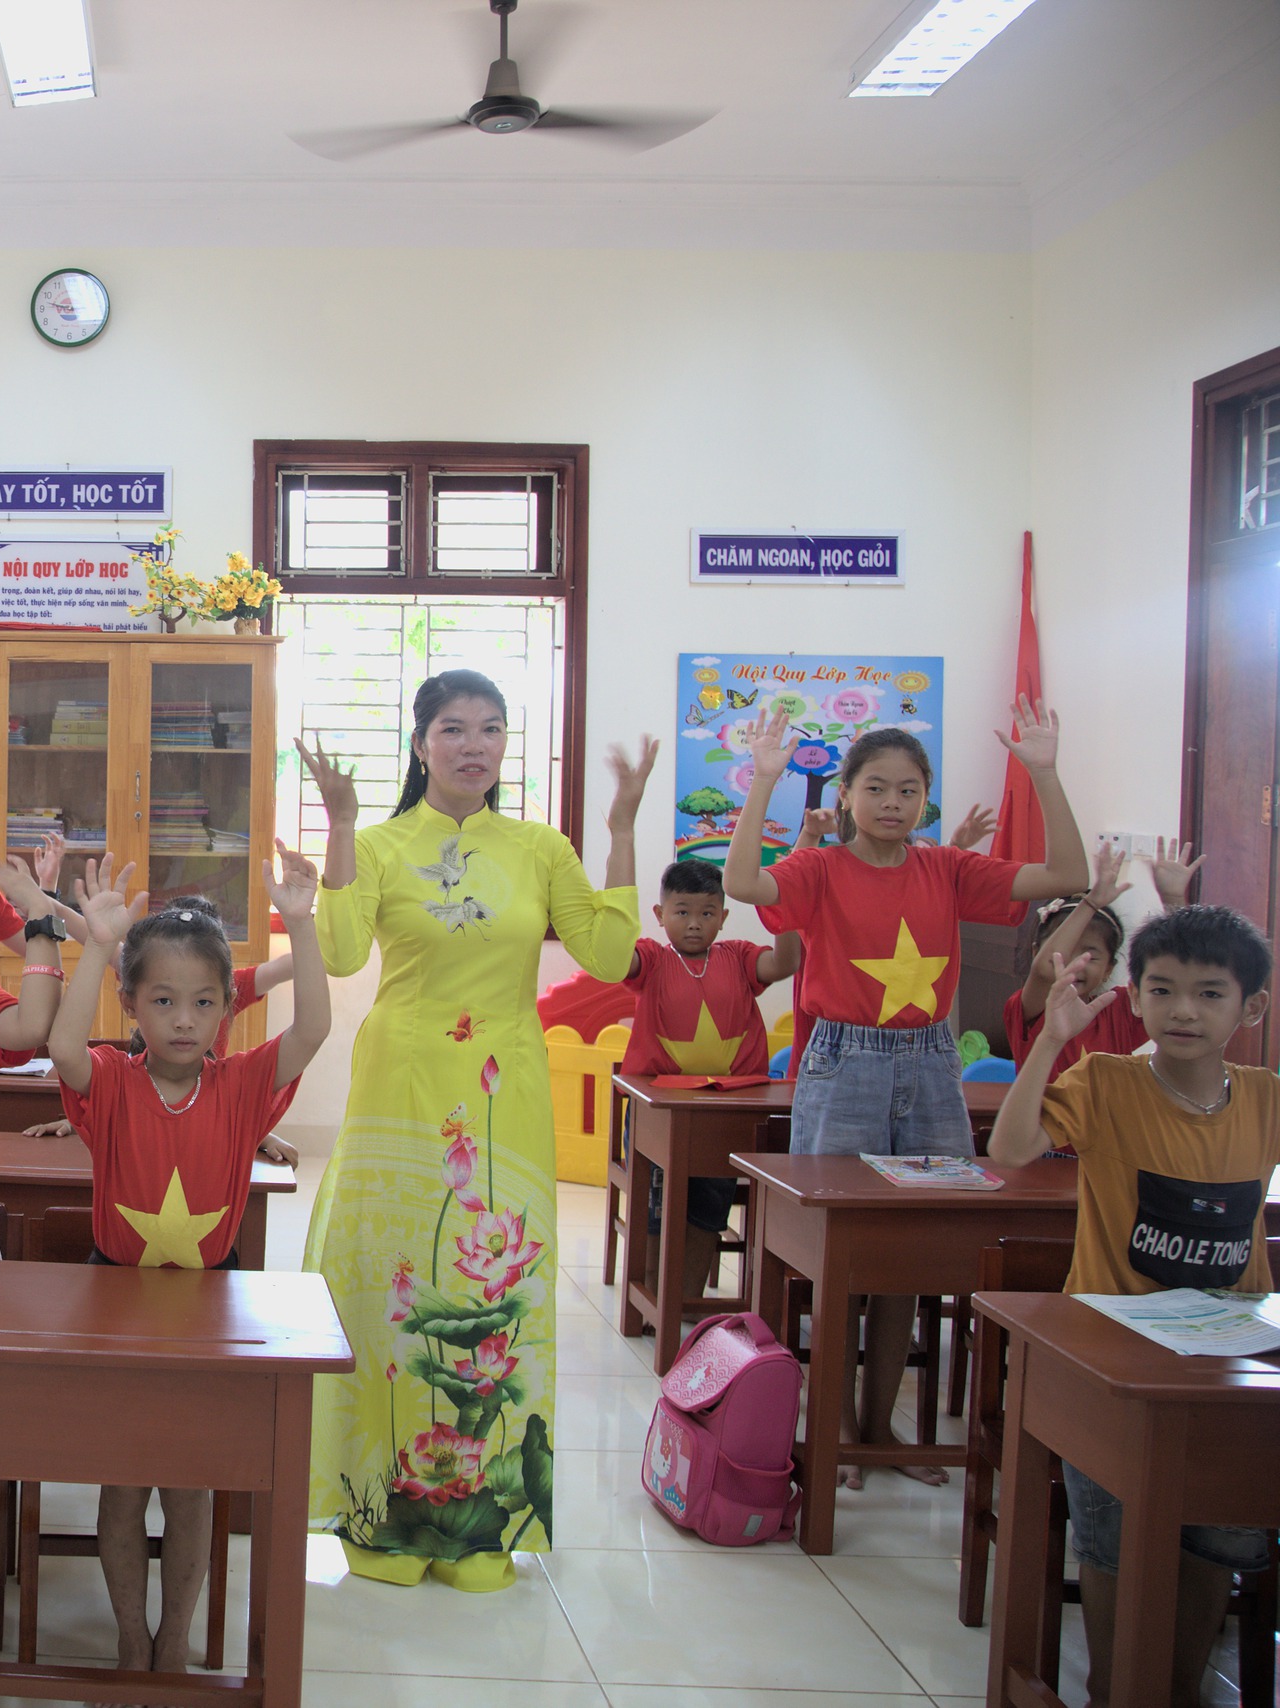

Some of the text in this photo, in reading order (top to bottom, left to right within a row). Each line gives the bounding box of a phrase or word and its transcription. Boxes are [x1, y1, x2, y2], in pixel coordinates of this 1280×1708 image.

[40, 305, 45, 313] 9
[43, 318, 48, 326] 8
[54, 328, 58, 336] 7
[67, 332, 72, 340] 6
[22, 477, 65, 506] TỐT,
[73, 484, 113, 507] HỌC
[119, 477, 157, 504] TỐT
[706, 543, 890, 570] CHĂM NGOAN, HỌC GIỎI
[3, 558, 128, 582] NỘI QUY LỚP HỌC
[2, 587, 22, 596] trọng,
[42, 587, 56, 595] kết,
[57, 587, 73, 596] giúp
[85, 588, 103, 596] nhau,
[128, 588, 142, 596] hay,
[17, 598, 29, 606] tốt,
[31, 599, 46, 607] thực
[48, 599, 62, 607] hiện
[64, 599, 76, 607] nếp
[79, 599, 95, 608] sống
[13, 610, 25, 618] học
[27, 610, 38, 619] tập
[116, 623, 131, 632] phát
[133, 622, 148, 630] biểu
[732, 664, 892, 685] Nội Quy Lớp Học
[1132, 1223, 1250, 1267] CHAO LE TONG
